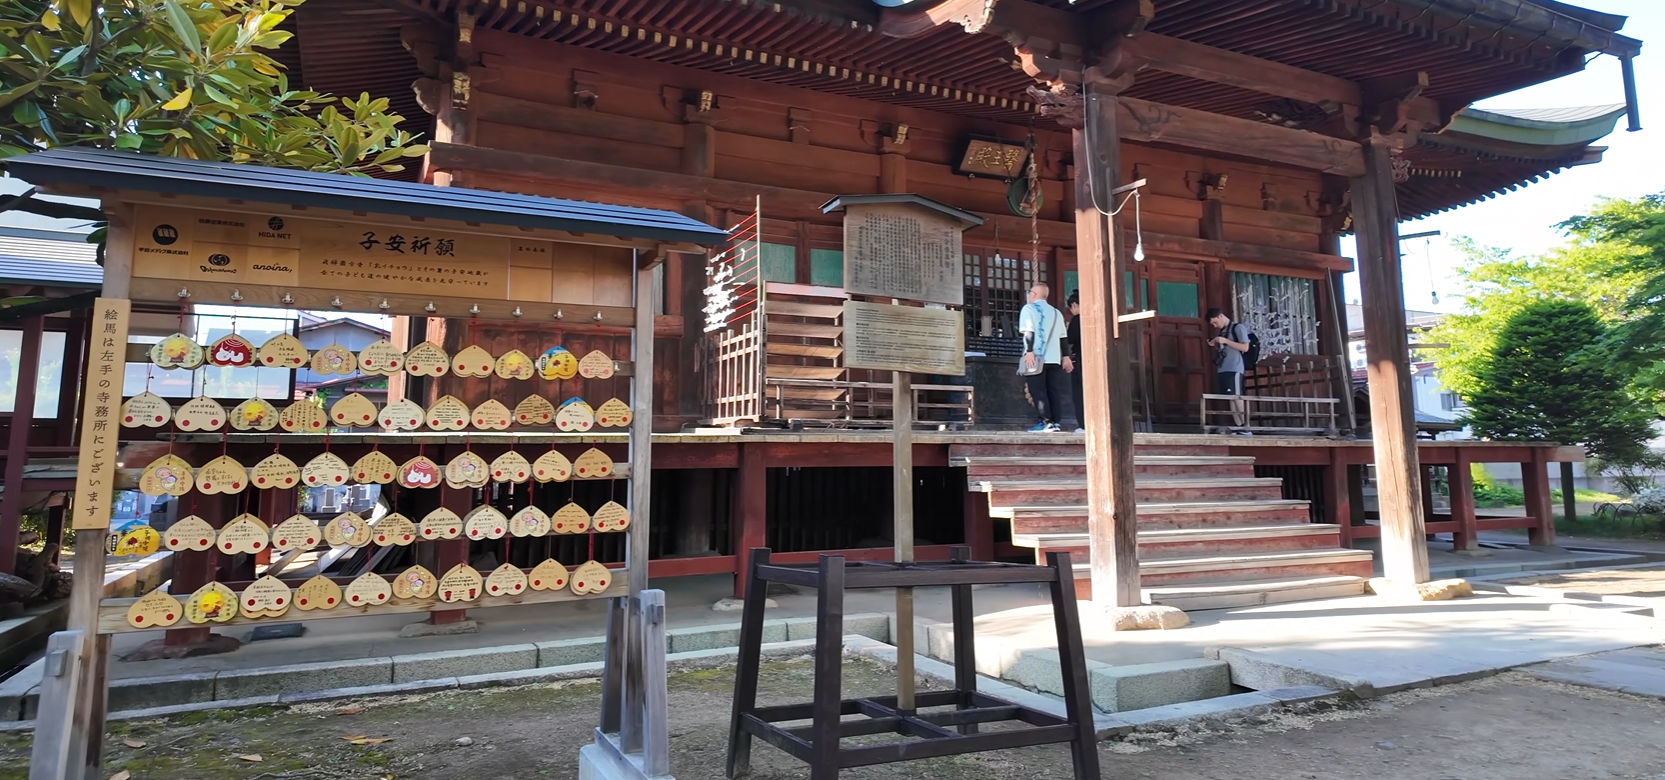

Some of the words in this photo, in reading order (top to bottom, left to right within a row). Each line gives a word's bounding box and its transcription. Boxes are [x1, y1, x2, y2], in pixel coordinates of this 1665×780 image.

[258, 231, 276, 239] HIDA
[359, 231, 456, 257] 子安祈願
[86, 309, 118, 517] 絵馬は左手の寺務所にございます
